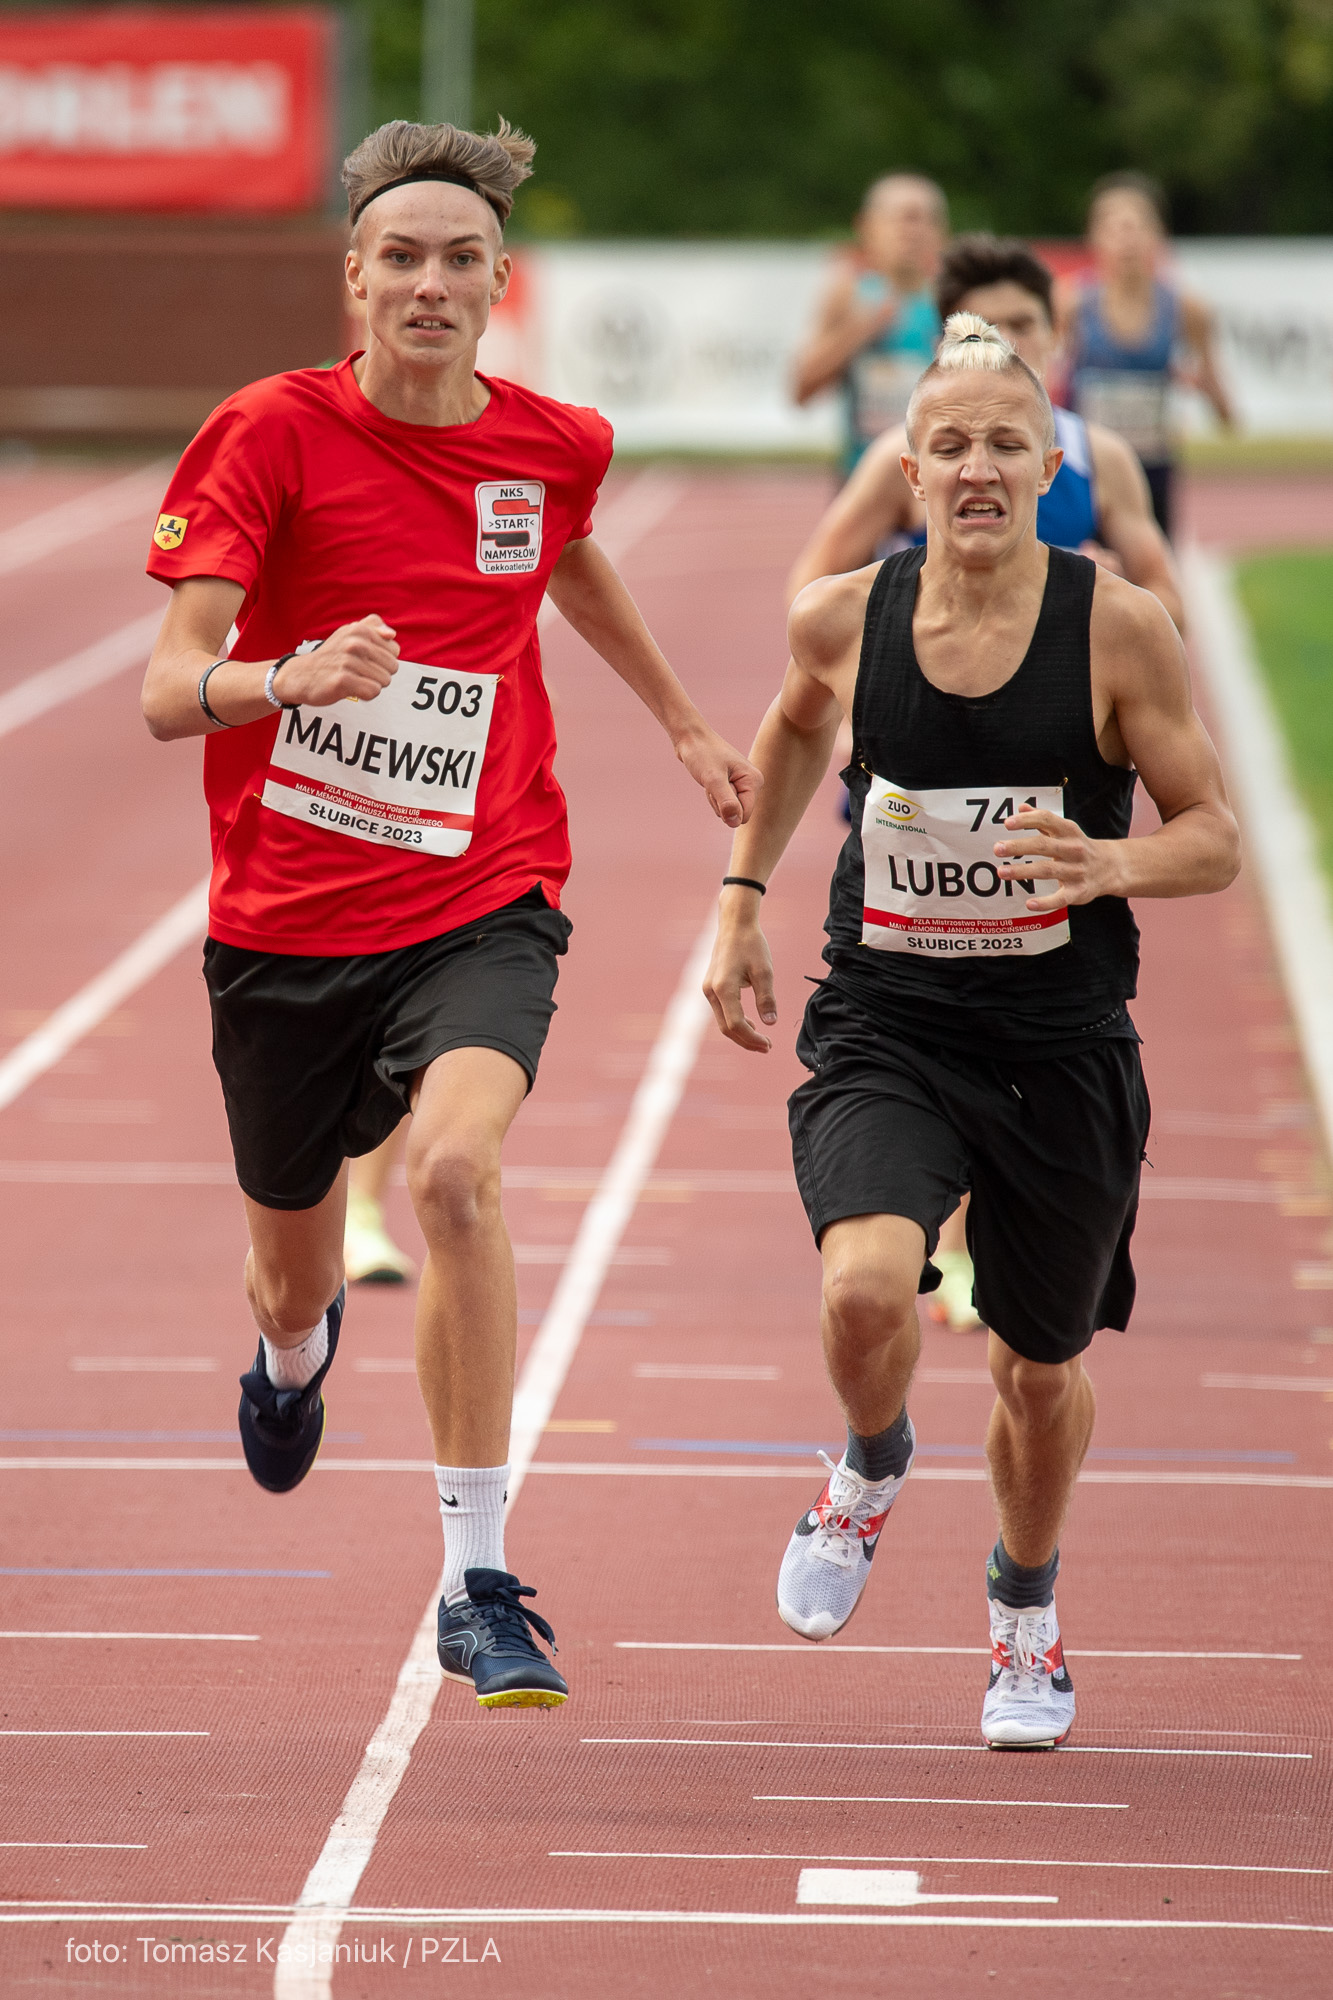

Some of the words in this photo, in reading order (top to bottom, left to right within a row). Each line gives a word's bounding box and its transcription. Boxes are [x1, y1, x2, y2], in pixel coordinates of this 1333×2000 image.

[500, 487, 523, 497] NKS
[485, 546, 536, 559] NAMYSŁÓW
[411, 676, 483, 718] 503
[285, 708, 476, 789] MAJEWSKI
[295, 783, 315, 797] MAŁY
[315, 788, 353, 810] MEMORIAŁ
[353, 801, 387, 819] JANUSZA
[388, 810, 443, 828] KUSOCIŃSKIEGO
[324, 784, 341, 797] PZLA
[342, 789, 385, 810] Mistrzostwa
[386, 801, 408, 814] Polski
[408, 807, 420, 816] U16
[888, 799, 911, 815] ZUO
[308, 802, 378, 834] SŁUBICE
[382, 825, 423, 844] 2023
[875, 817, 928, 834] INTERNATIONAL
[889, 921, 907, 931] MAŁY
[908, 925, 946, 933] MEMORIAŁ
[946, 926, 981, 934] JANUSZA
[981, 923, 1042, 934] KUSOCIŃSKIEGO
[913, 918, 930, 926] PZLA
[932, 918, 976, 927] Mistrzostwa
[977, 919, 998, 927] Polski
[907, 936, 977, 951] SŁUBICE
[981, 937, 1024, 949] 2023
